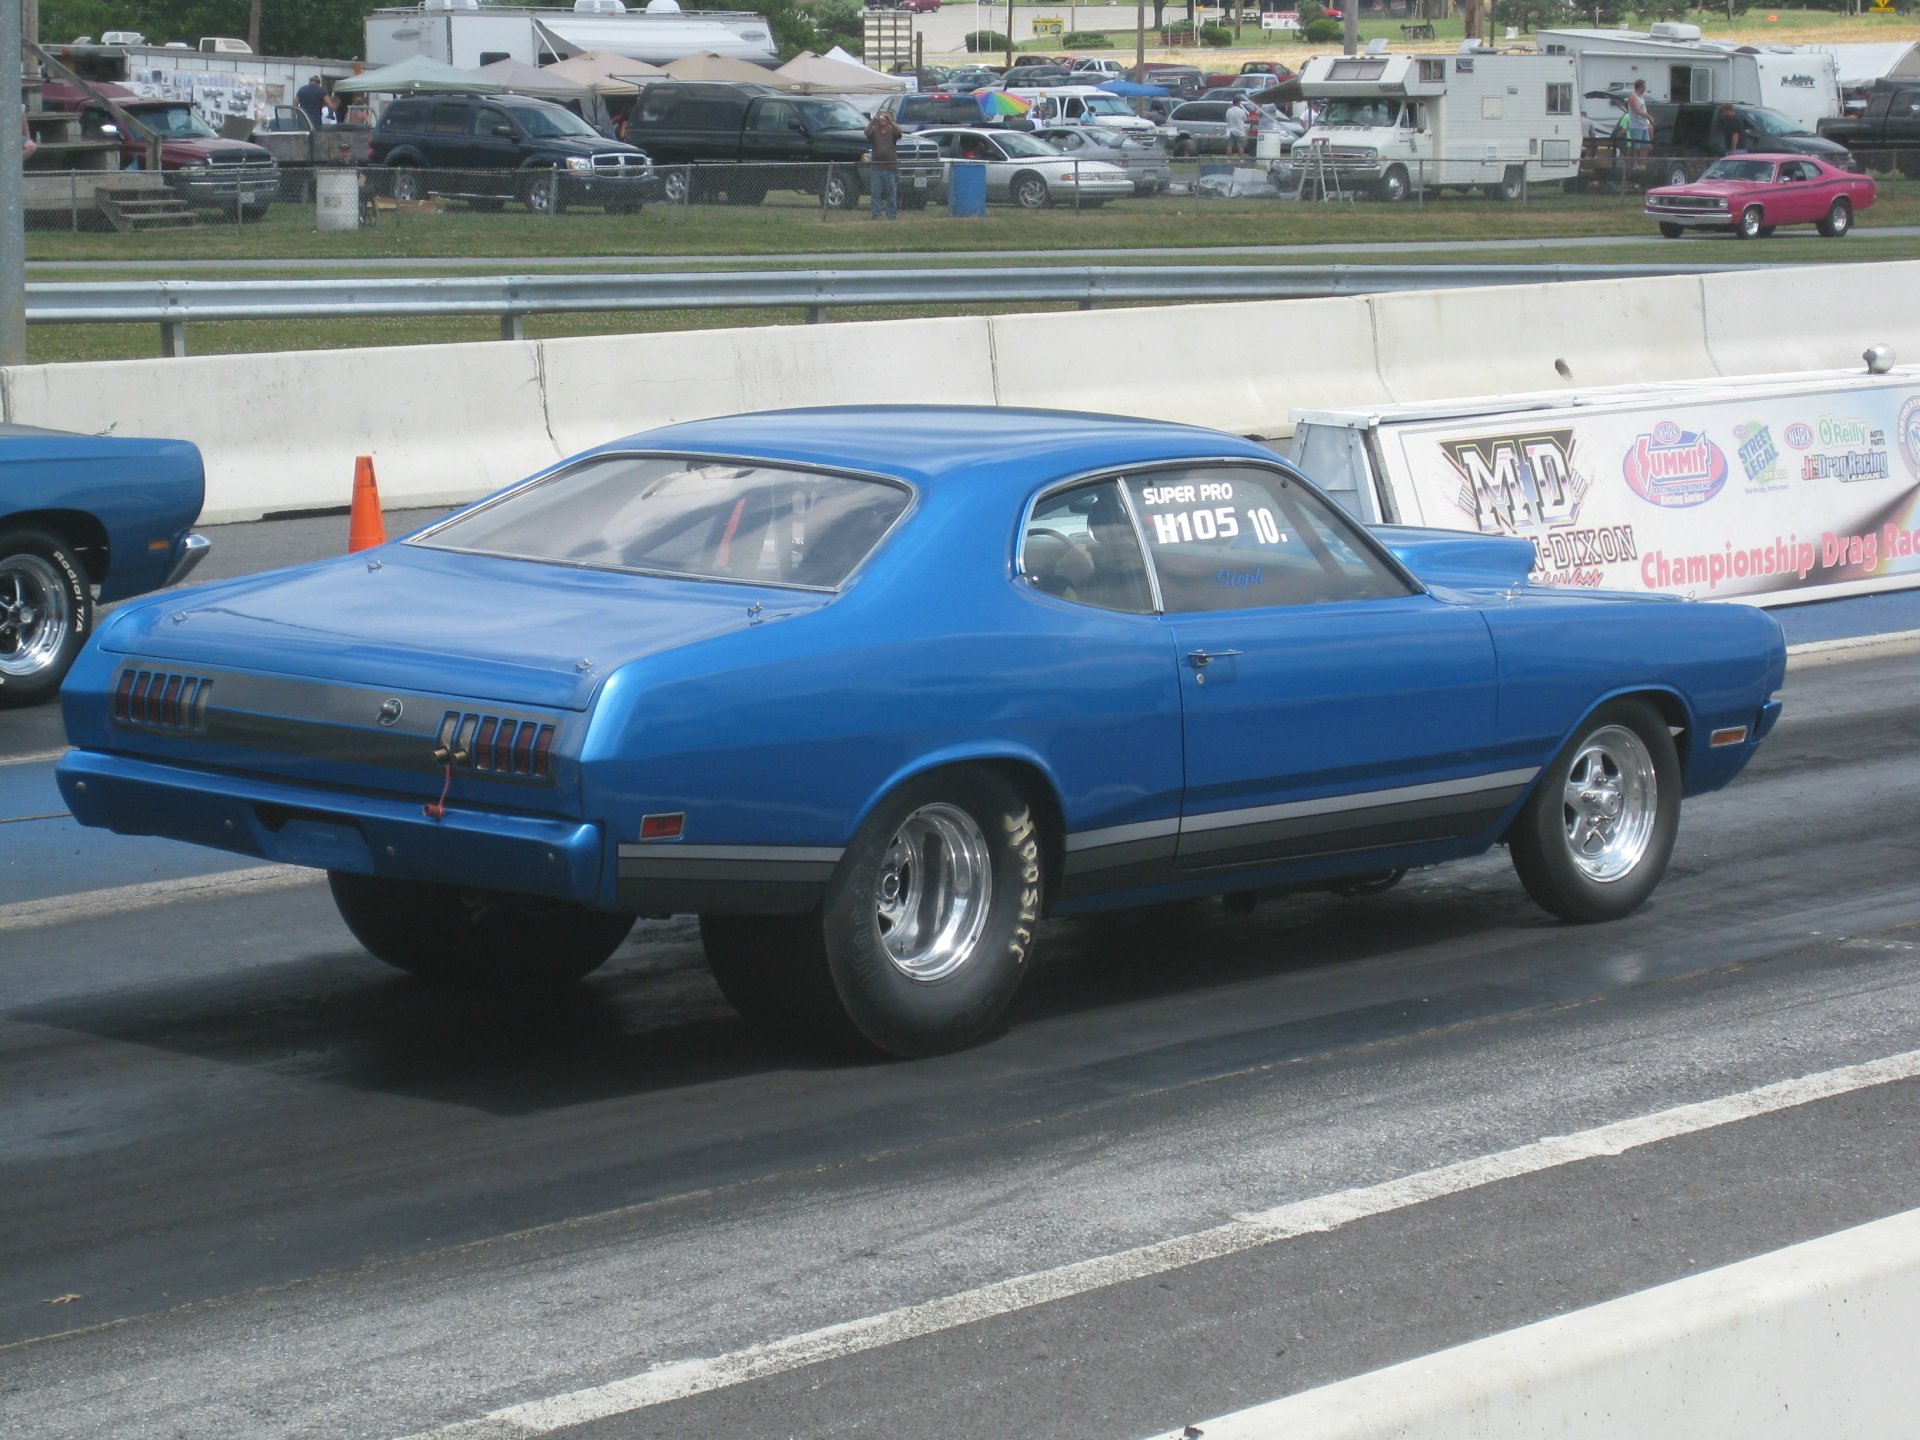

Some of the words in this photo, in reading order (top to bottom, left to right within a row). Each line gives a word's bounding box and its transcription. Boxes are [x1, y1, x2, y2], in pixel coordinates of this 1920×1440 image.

[1657, 424, 1679, 441] NHRA
[1738, 425, 1772, 464] STREET
[1786, 426, 1812, 447] NHRA
[1819, 417, 1866, 446] O'Reilly
[1869, 430, 1885, 438] AUTO
[1870, 438, 1886, 446] PARTS
[1744, 443, 1780, 482] LEGAL
[1848, 473, 1880, 481] LEAGUE
[1143, 486, 1196, 505] SUPER
[1200, 483, 1233, 501] PRO
[1461, 438, 1580, 532] MD
[1153, 507, 1239, 544] H105
[1248, 508, 1288, 544] 10.
[1641, 533, 1815, 589] Championship
[1822, 532, 1877, 571] Drag
[53, 551, 83, 600] Radial
[75, 605, 85, 632] T/A
